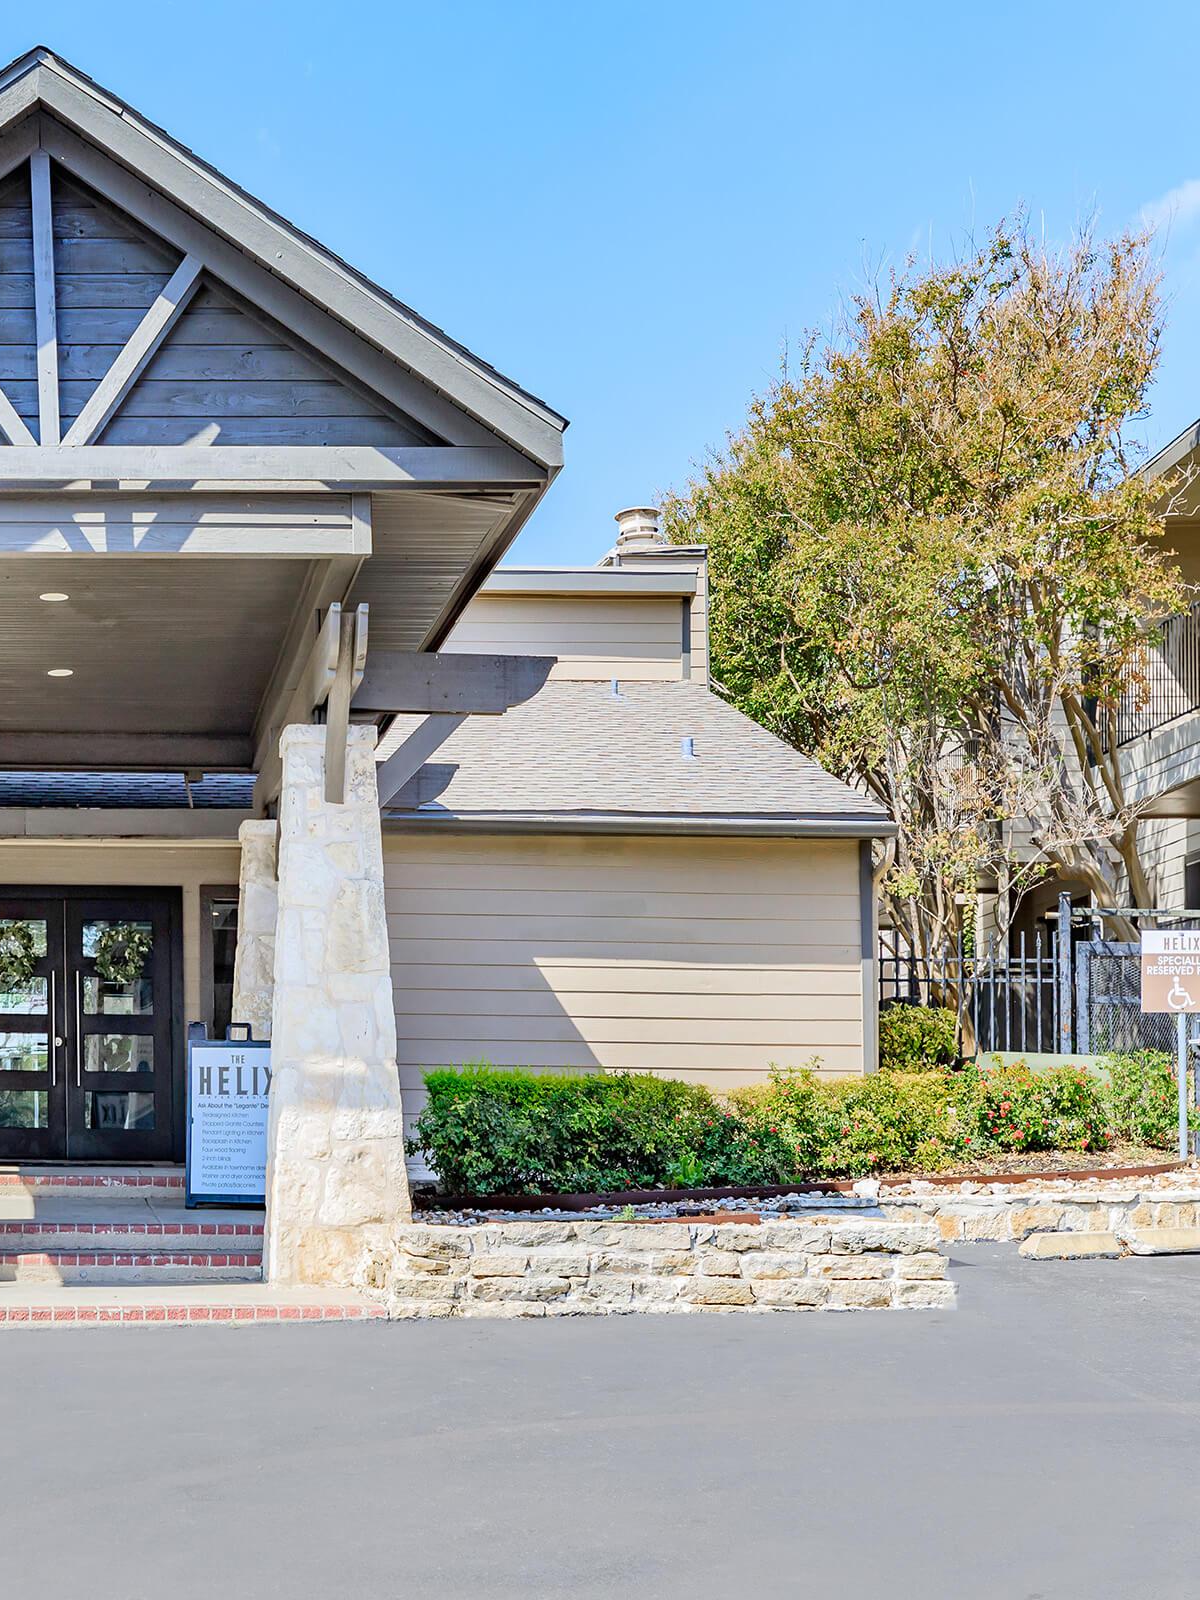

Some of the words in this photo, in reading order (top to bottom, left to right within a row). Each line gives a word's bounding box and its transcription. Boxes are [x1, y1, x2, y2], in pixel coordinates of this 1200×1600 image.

[1163, 937, 1200, 951] HELIX
[1146, 966, 1194, 975] RESERVED
[231, 1054, 246, 1064] THE
